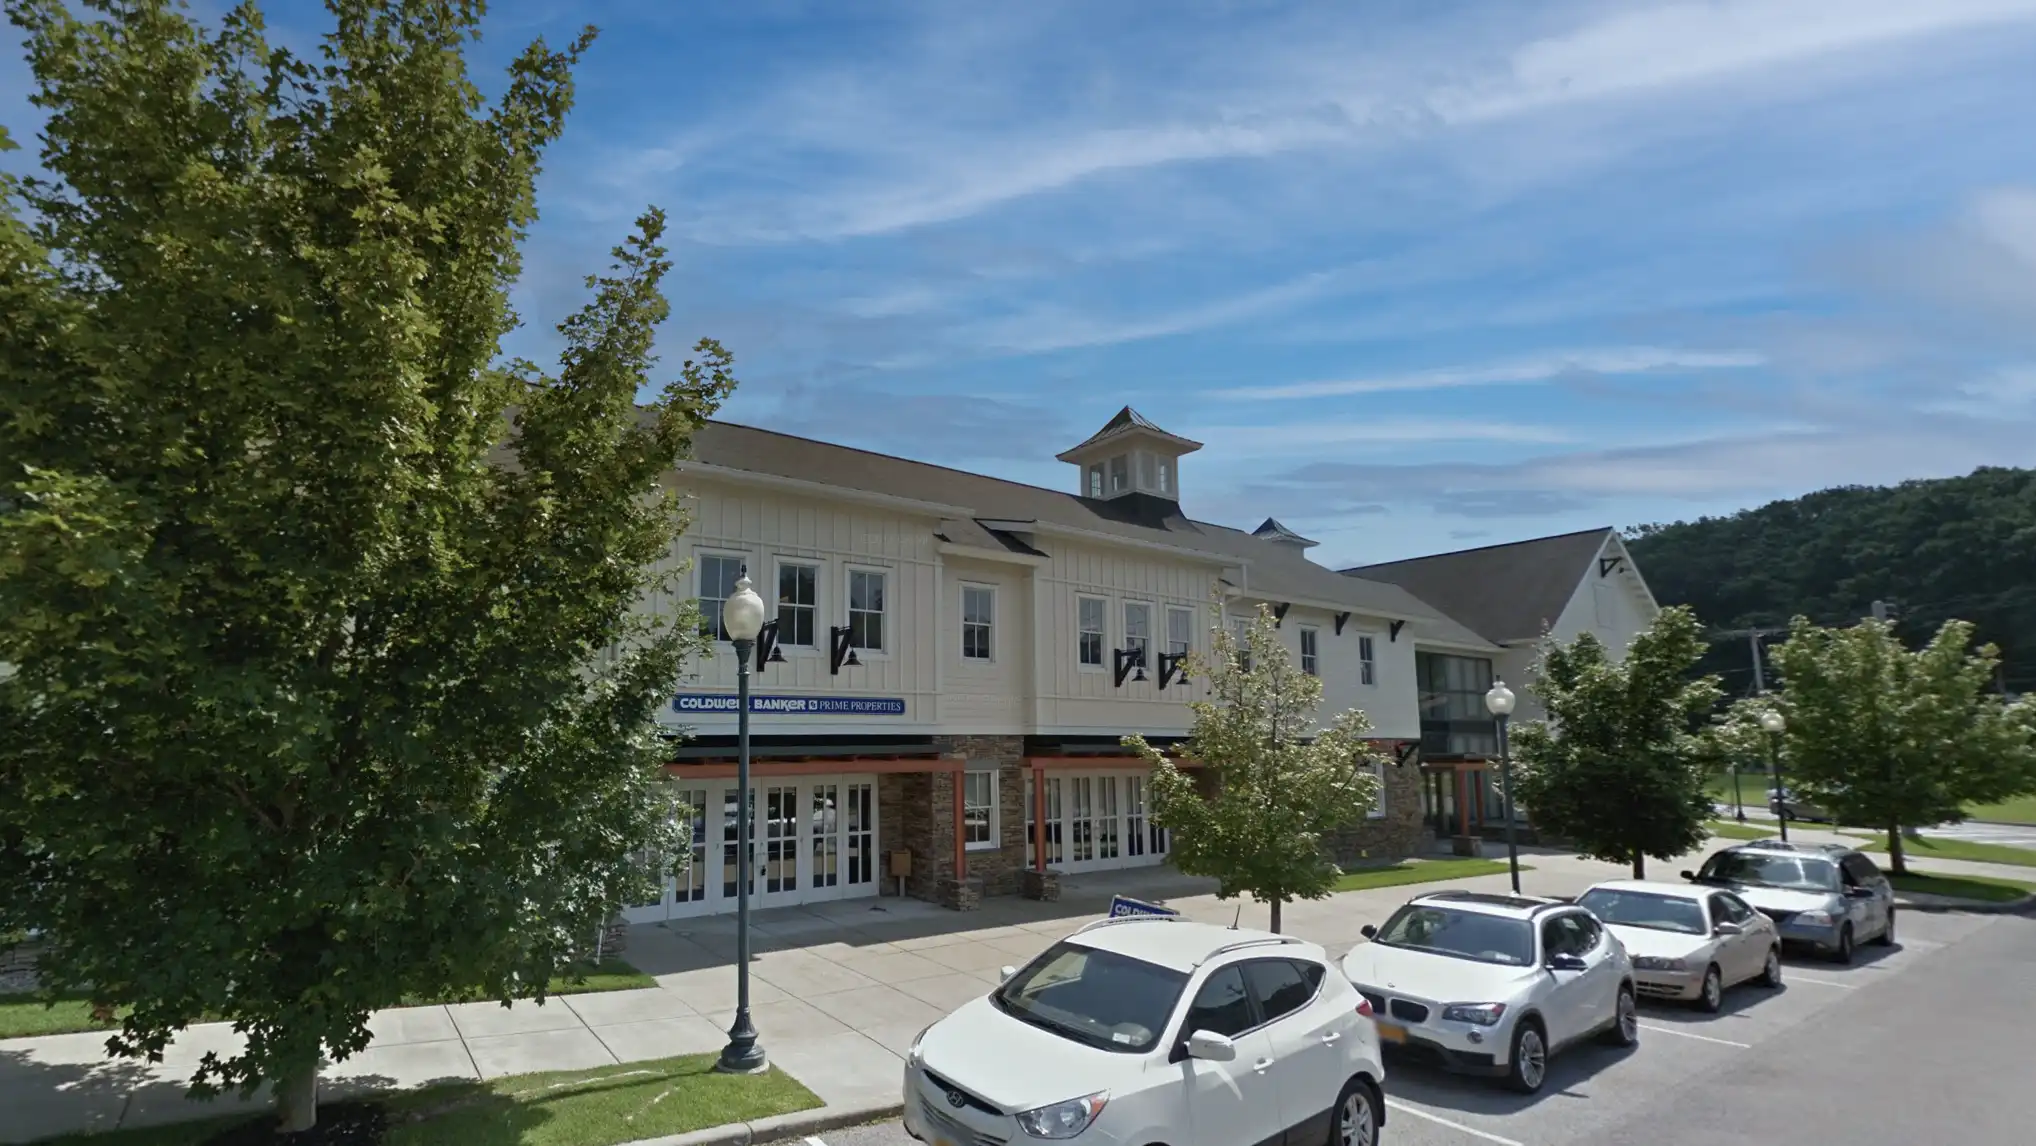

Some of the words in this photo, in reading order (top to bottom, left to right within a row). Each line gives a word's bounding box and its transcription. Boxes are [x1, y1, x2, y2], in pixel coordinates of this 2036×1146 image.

[680, 697, 750, 710] COLDWEL
[753, 698, 806, 711] BANKER
[819, 701, 849, 710] PRIME
[851, 701, 901, 711] PROPERTIES
